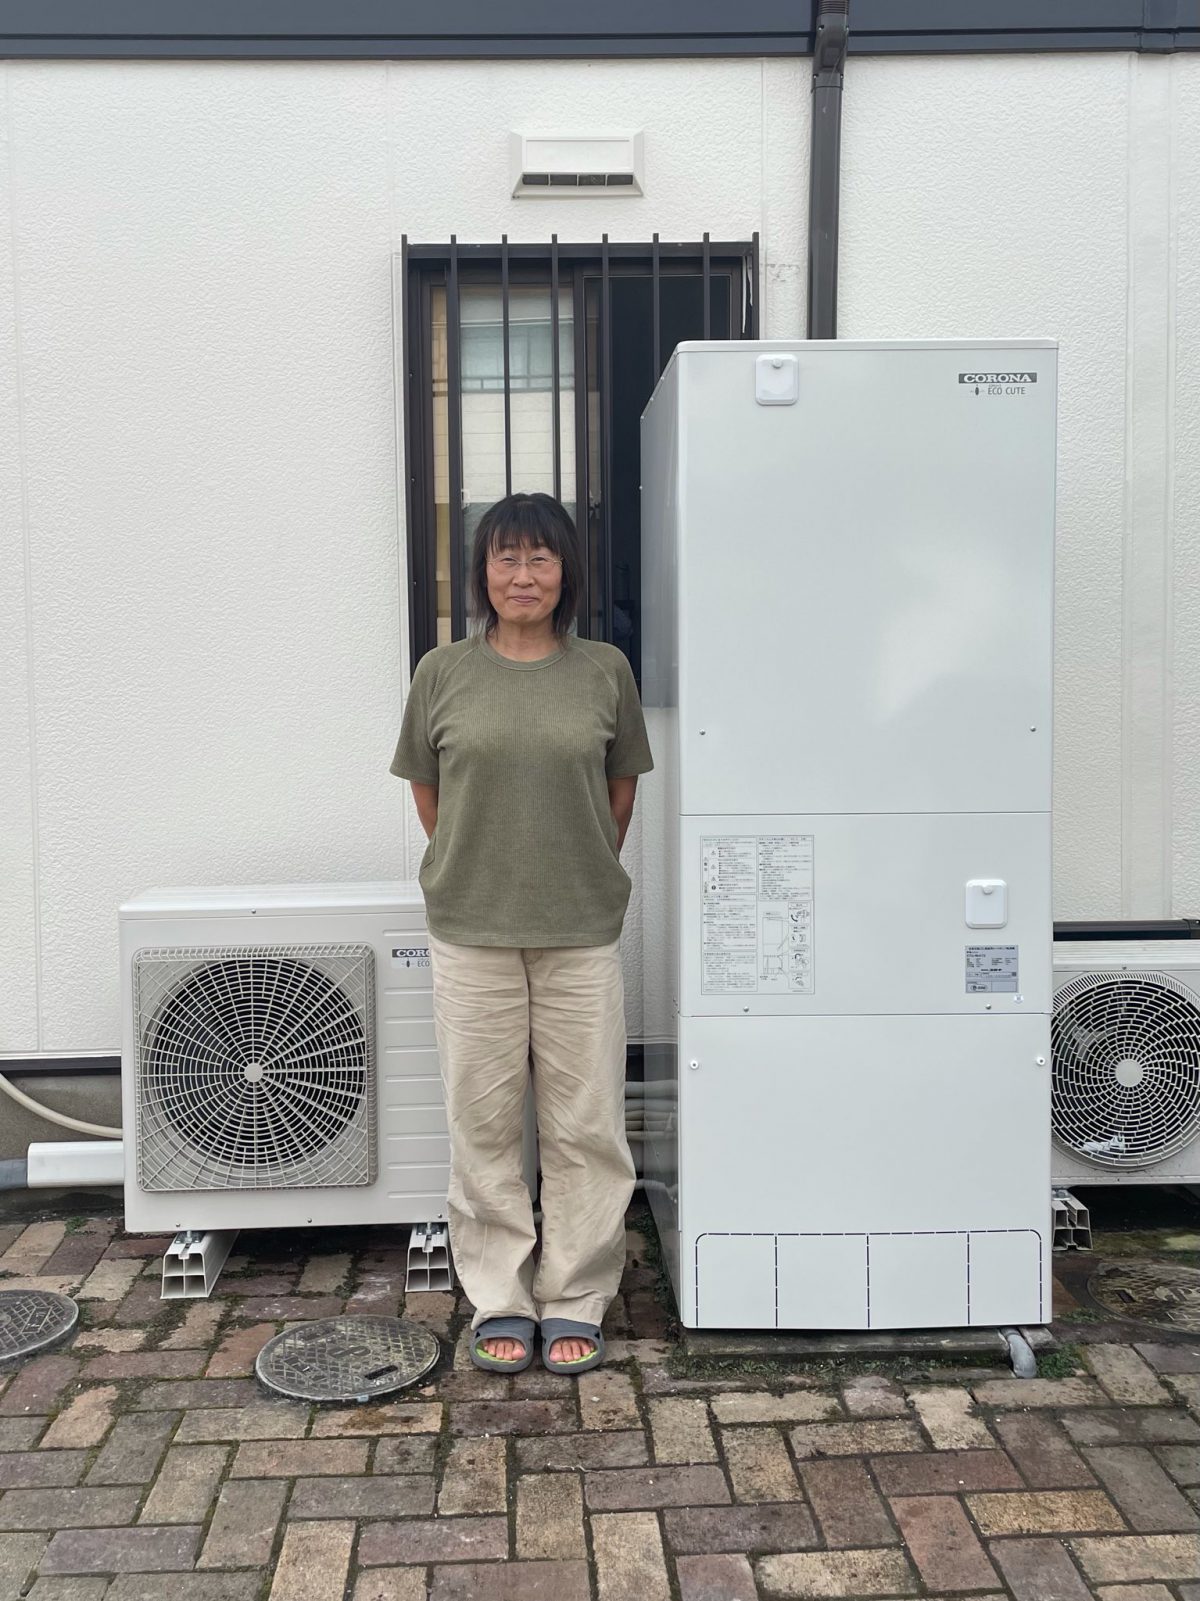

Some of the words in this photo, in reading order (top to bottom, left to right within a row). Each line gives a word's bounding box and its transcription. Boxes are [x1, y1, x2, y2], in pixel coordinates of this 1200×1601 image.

[963, 373, 1032, 383] CORONA
[987, 386, 1003, 395] ECO
[1005, 386, 1026, 395] CUTE
